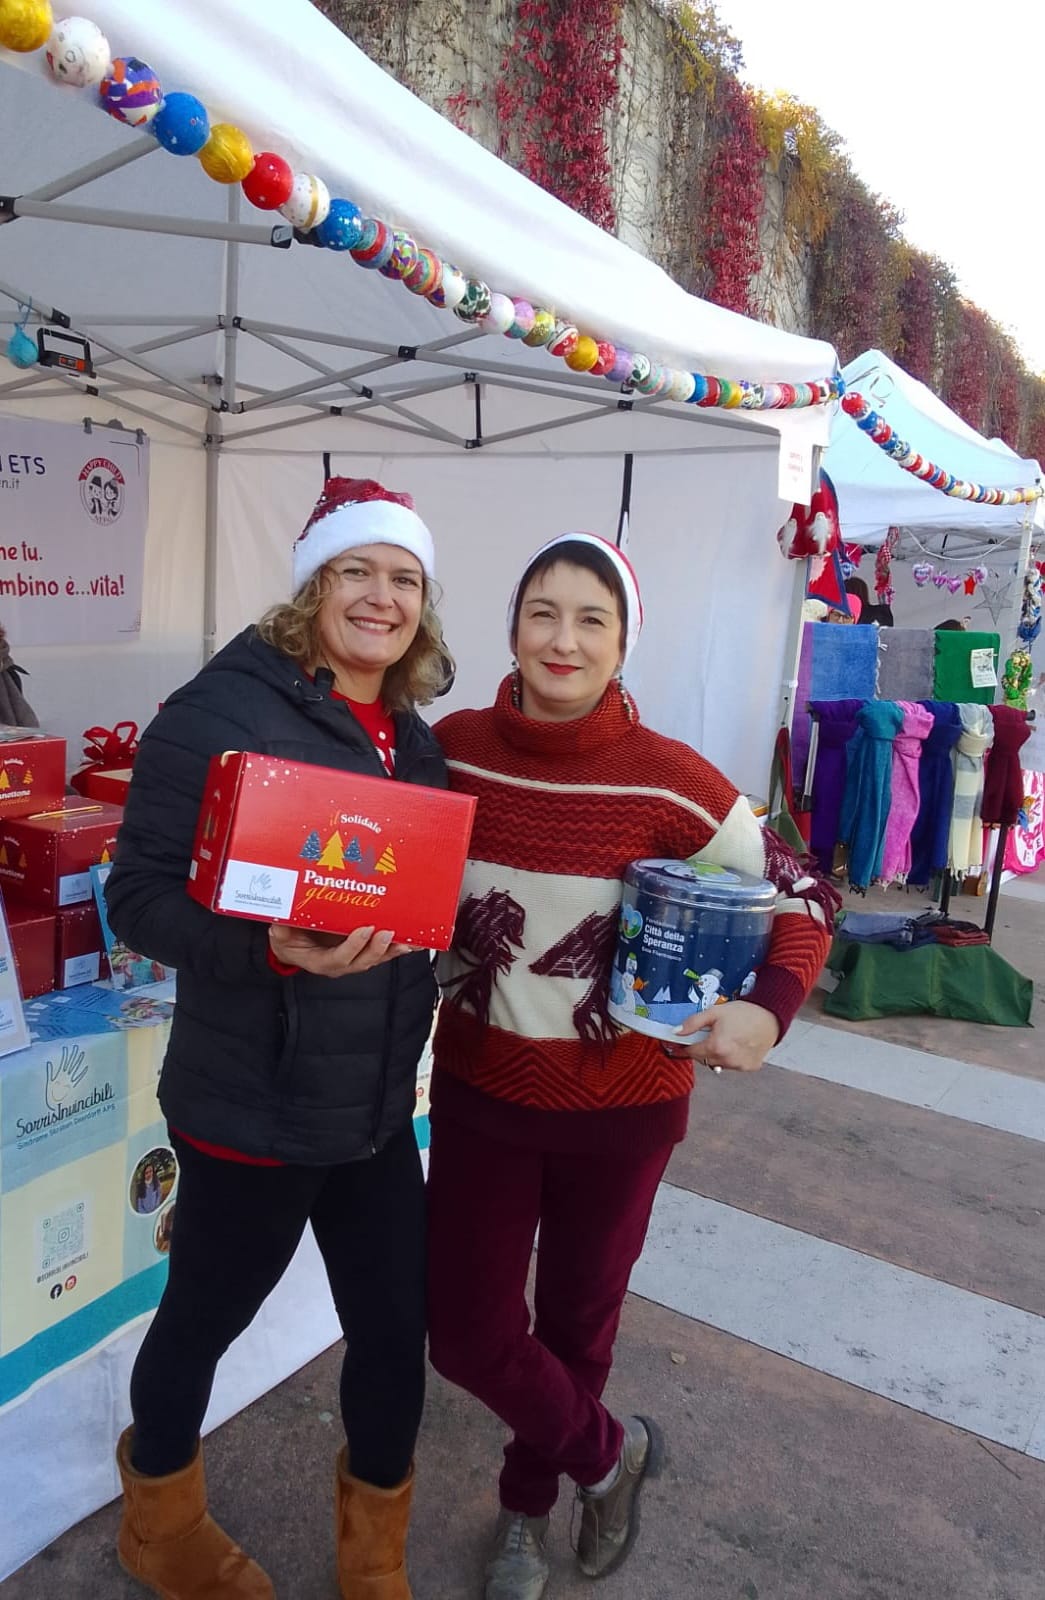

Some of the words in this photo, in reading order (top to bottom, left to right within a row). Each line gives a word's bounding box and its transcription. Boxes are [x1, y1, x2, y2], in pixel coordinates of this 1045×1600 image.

[8, 454, 46, 476] ETS
[0, 478, 20, 490] n.it
[21, 541, 43, 562] tu.
[0, 572, 59, 597] mbino
[340, 813, 382, 834] Solidale
[303, 869, 387, 896] Panettone
[296, 882, 381, 911] glassato
[643, 934, 684, 953] Speranza
[644, 924, 663, 937] Città
[664, 930, 685, 943] della
